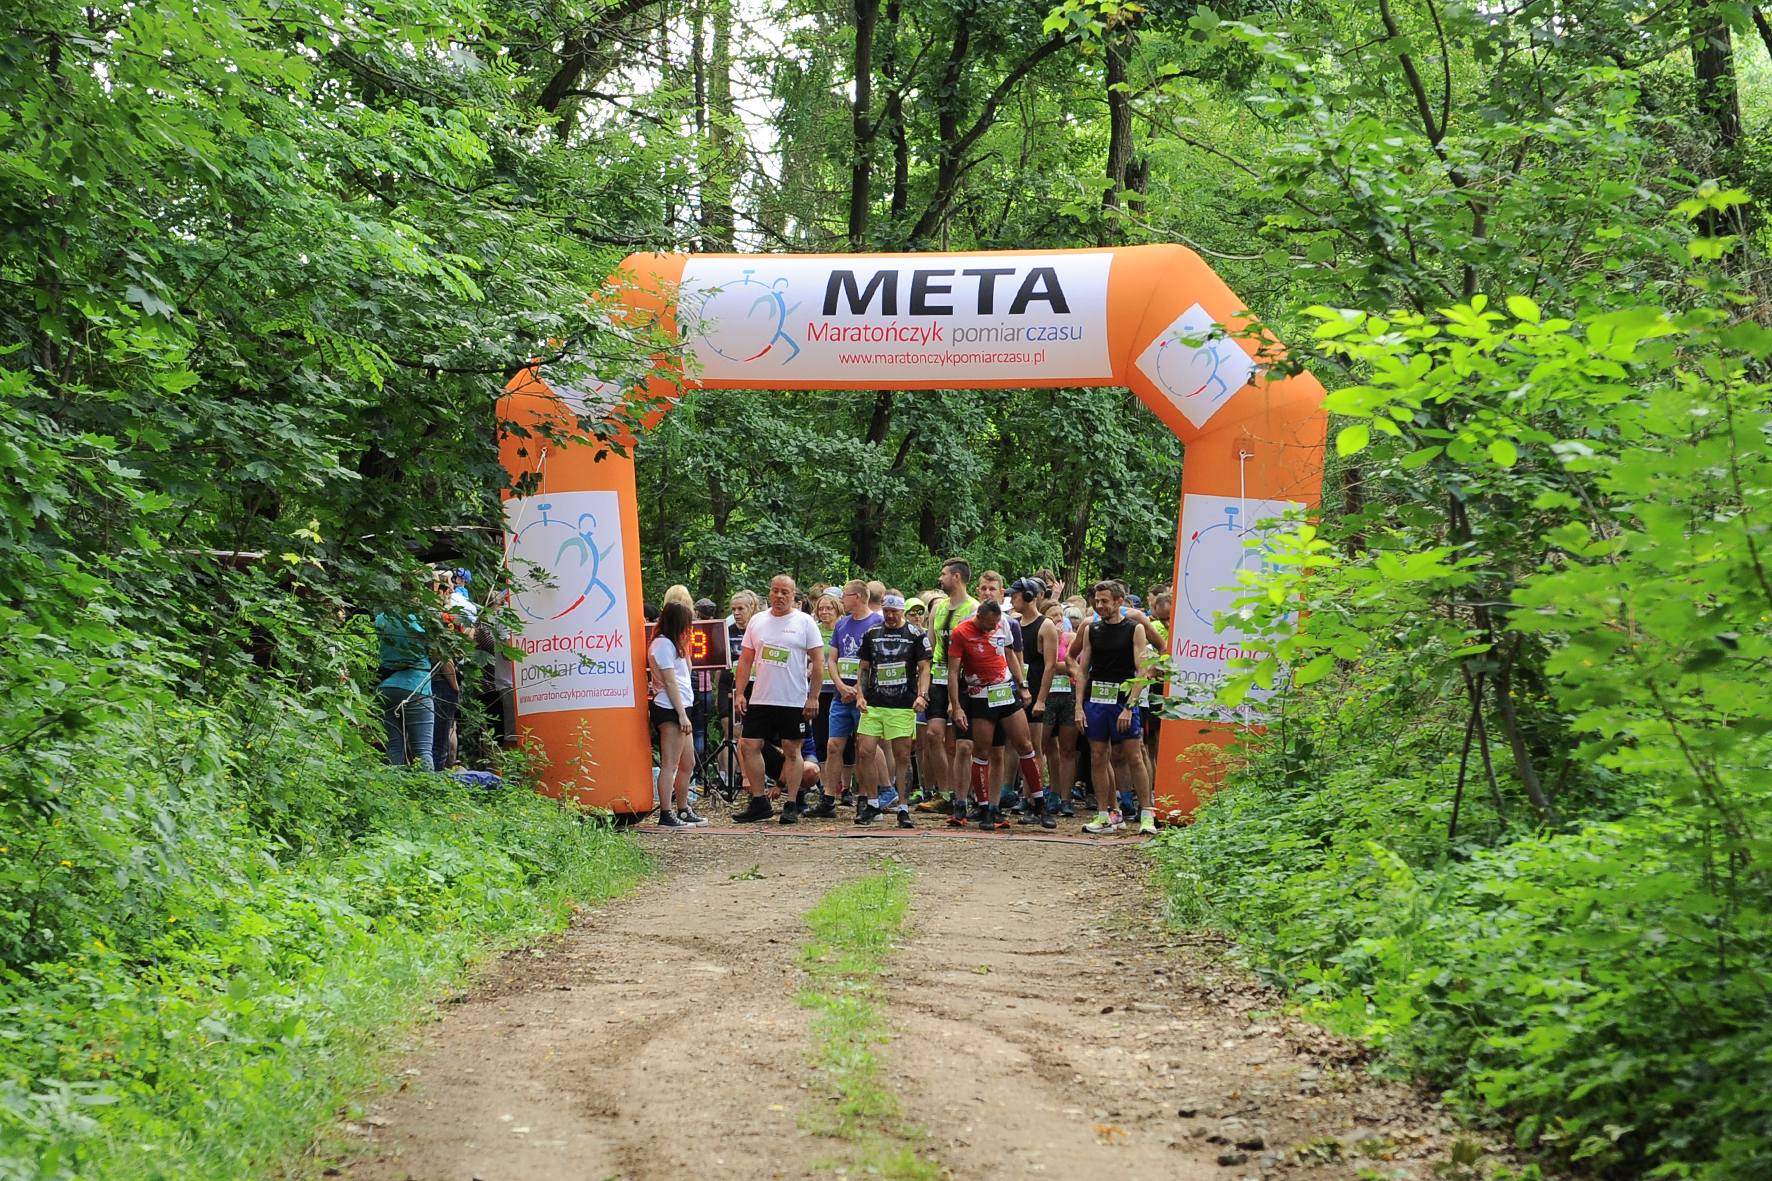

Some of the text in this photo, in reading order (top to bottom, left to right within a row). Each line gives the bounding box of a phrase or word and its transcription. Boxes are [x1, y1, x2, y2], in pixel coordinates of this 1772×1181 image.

[821, 266, 1071, 316] META
[807, 320, 944, 345] Maratończyk
[838, 350, 1046, 366] www.maratonczykpomiarczasu.pl
[515, 629, 623, 655] Maratończyk
[886, 668, 897, 677] 65
[1099, 687, 1109, 696] 28
